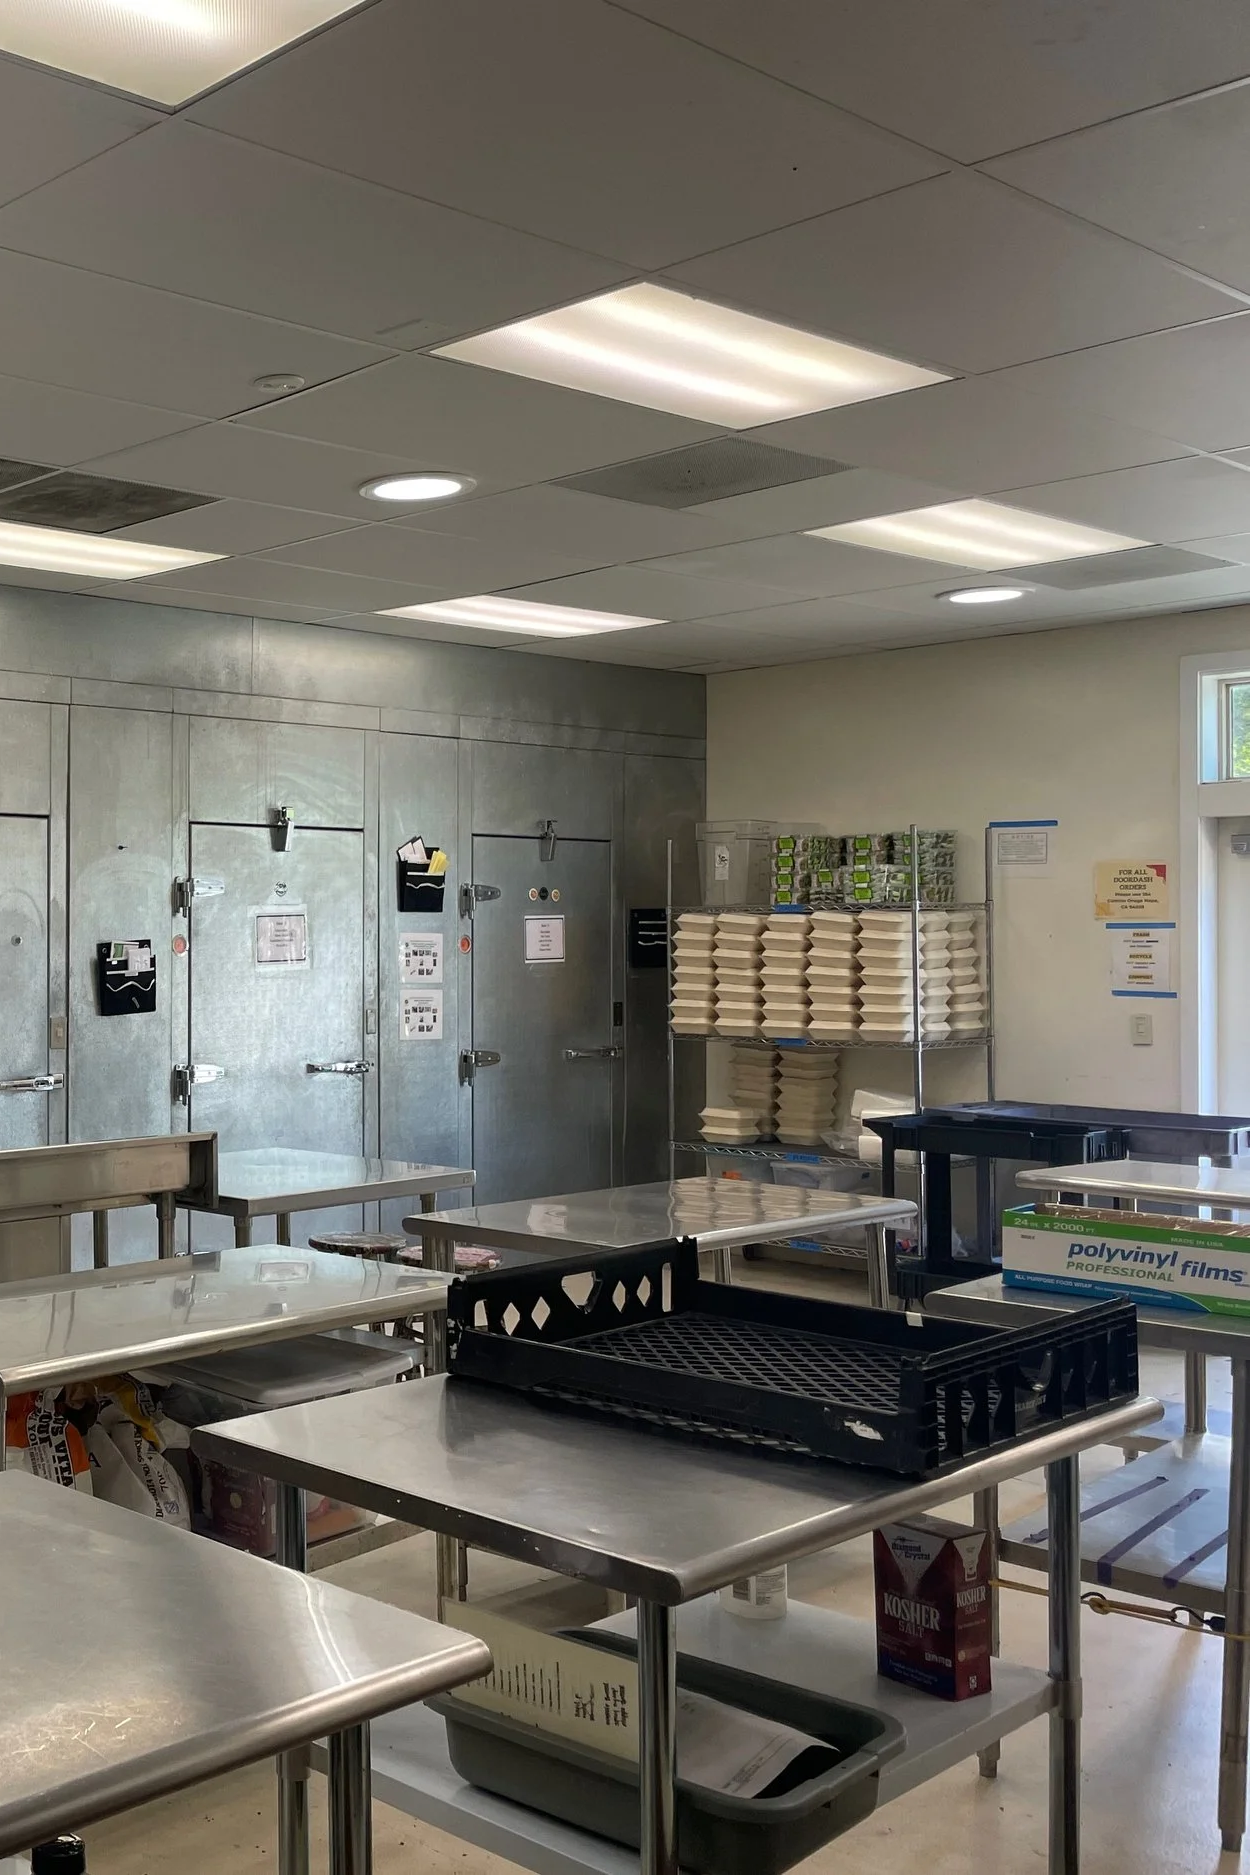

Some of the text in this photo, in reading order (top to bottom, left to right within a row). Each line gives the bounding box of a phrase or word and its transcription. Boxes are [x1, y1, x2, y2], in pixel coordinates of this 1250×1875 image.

[1013, 1217, 1029, 1227] 24
[1053, 1221, 1084, 1232] 2000
[1170, 1236, 1195, 1246] MADE
[1067, 1241, 1244, 1283] polyvinyl films
[1066, 1260, 1175, 1283] PROFESSIONAL
[1014, 1273, 1093, 1289] ALL PURPOSE FOOD WRAP
[891, 1541, 922, 1553] Diamond
[904, 1551, 931, 1561] Crystal
[956, 1585, 987, 1608] KOSHER
[883, 1591, 941, 1631] KOSHER
[964, 1604, 979, 1616] SALT
[898, 1619, 925, 1639] SALT
